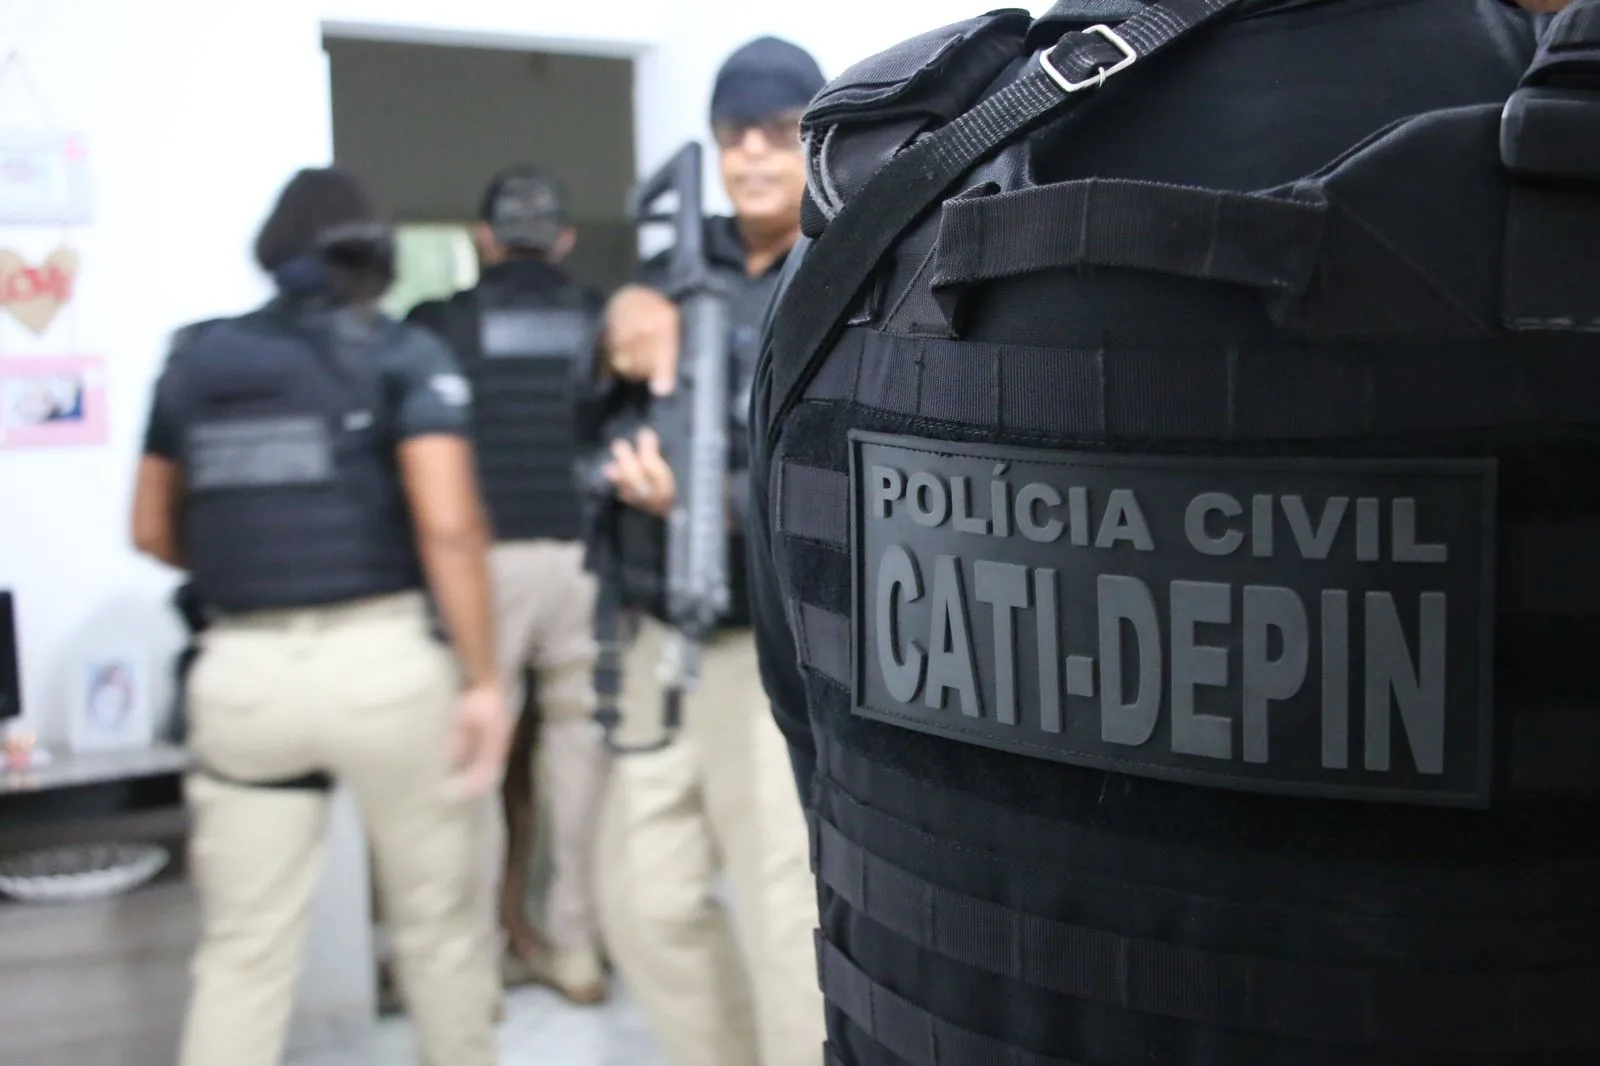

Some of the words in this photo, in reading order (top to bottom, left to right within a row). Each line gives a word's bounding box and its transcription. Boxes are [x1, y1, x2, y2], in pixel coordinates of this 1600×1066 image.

[871, 464, 1155, 551] POLÍCIA
[1184, 492, 1447, 563] CIVIL
[876, 545, 1447, 775] CATI-DEPIN
